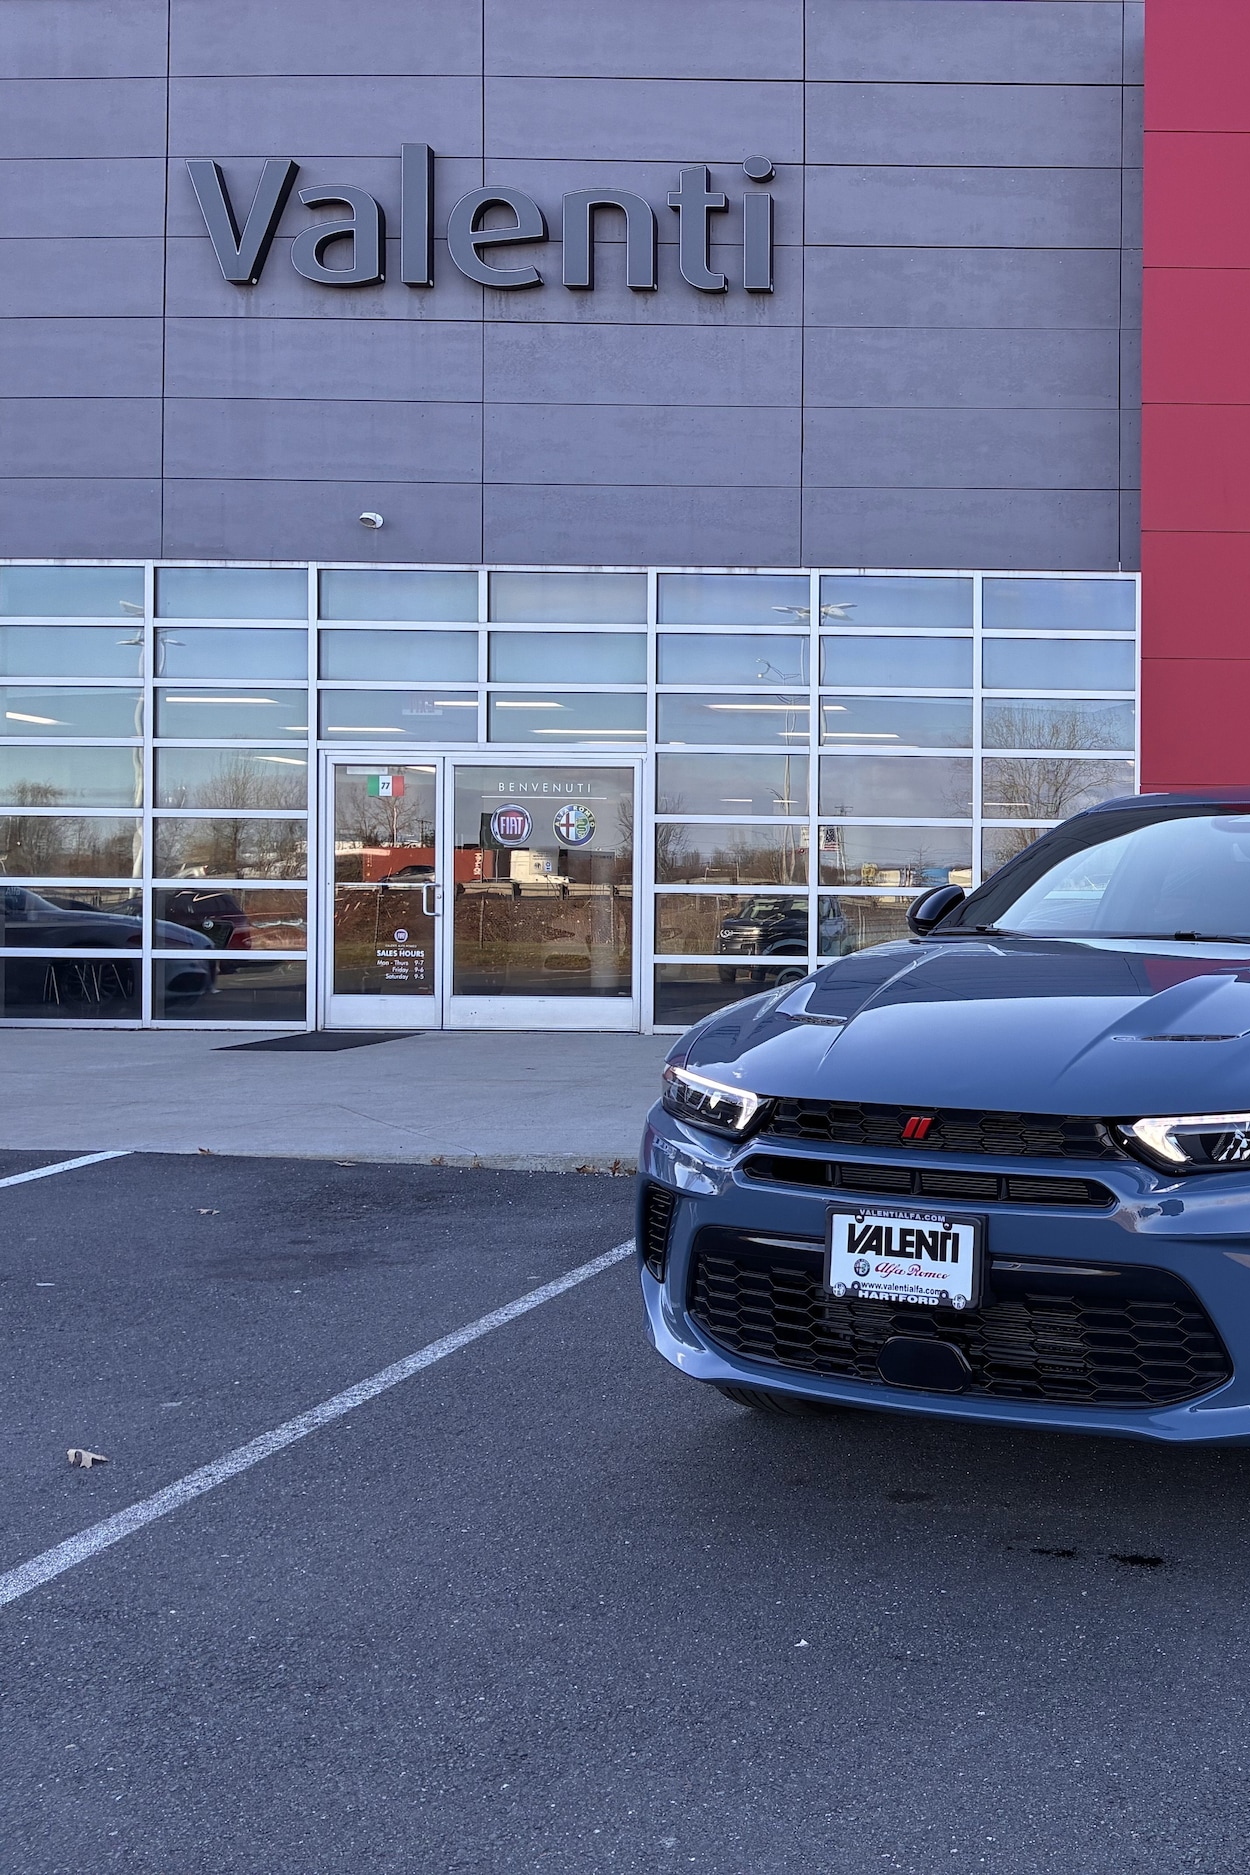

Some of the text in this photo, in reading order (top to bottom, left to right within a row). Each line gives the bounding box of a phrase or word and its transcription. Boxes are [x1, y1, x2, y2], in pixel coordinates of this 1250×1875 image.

[185, 143, 776, 293] Valenti
[381, 782, 390, 790] 77
[498, 782, 591, 793] BENVENUTI
[554, 805, 595, 828] ALFA ROMEO
[500, 816, 523, 835] FIAT
[859, 1209, 946, 1223] VALENTIALFA.COM
[847, 1223, 960, 1263] VALENTI
[874, 1262, 905, 1279] Alfa
[906, 1264, 950, 1280] Romeo
[861, 1281, 941, 1297] www.valentialfa.com
[858, 1290, 940, 1306] HARTFORD
